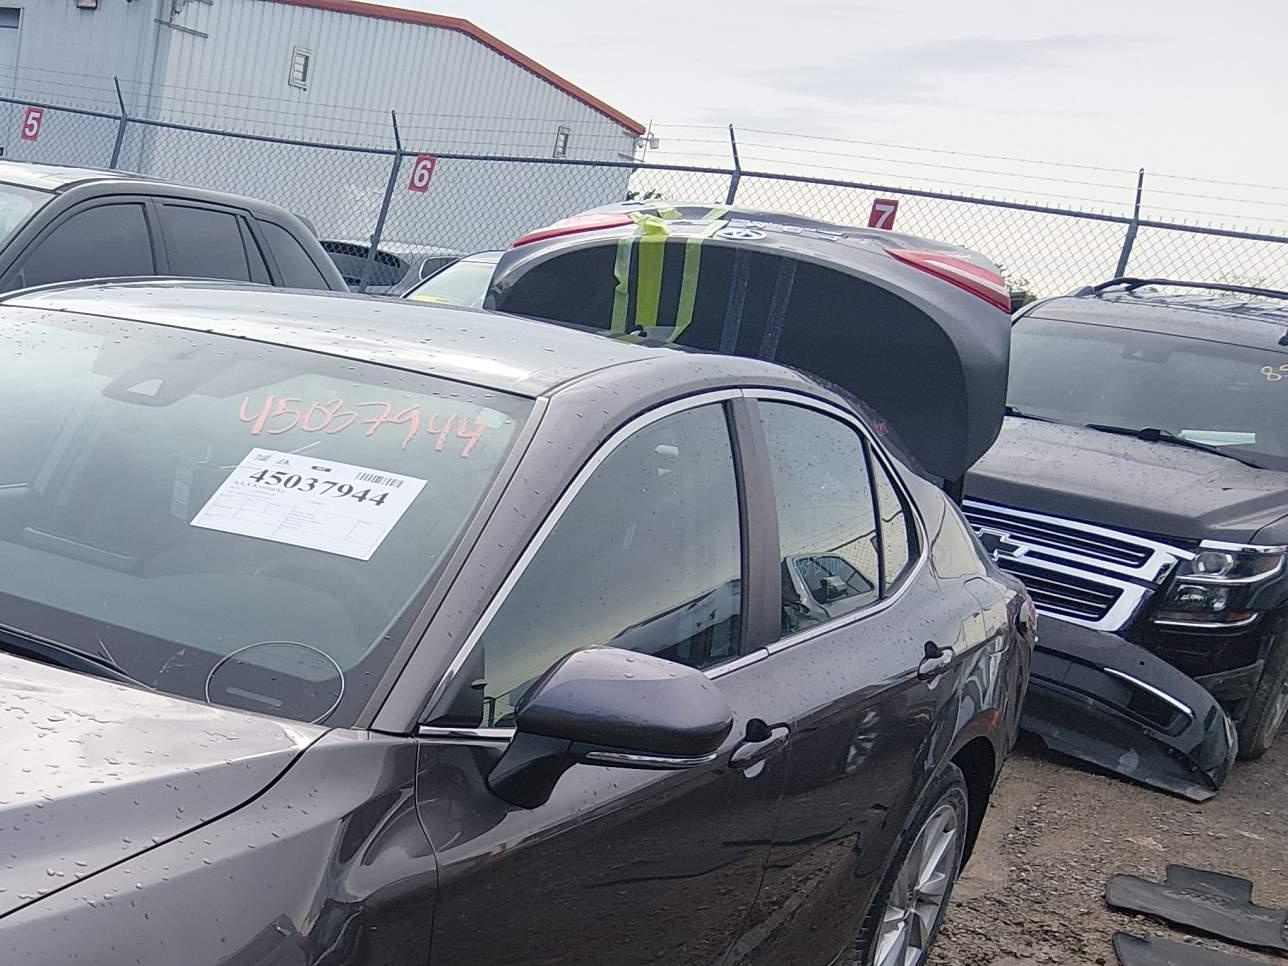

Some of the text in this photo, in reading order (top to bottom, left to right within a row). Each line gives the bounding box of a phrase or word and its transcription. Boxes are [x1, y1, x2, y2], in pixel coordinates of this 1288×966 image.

[24, 111, 40, 137] 5
[414, 160, 431, 187] 6
[875, 204, 895, 229] 7
[239, 396, 488, 458] 45037944
[249, 469, 389, 506] 45037944
